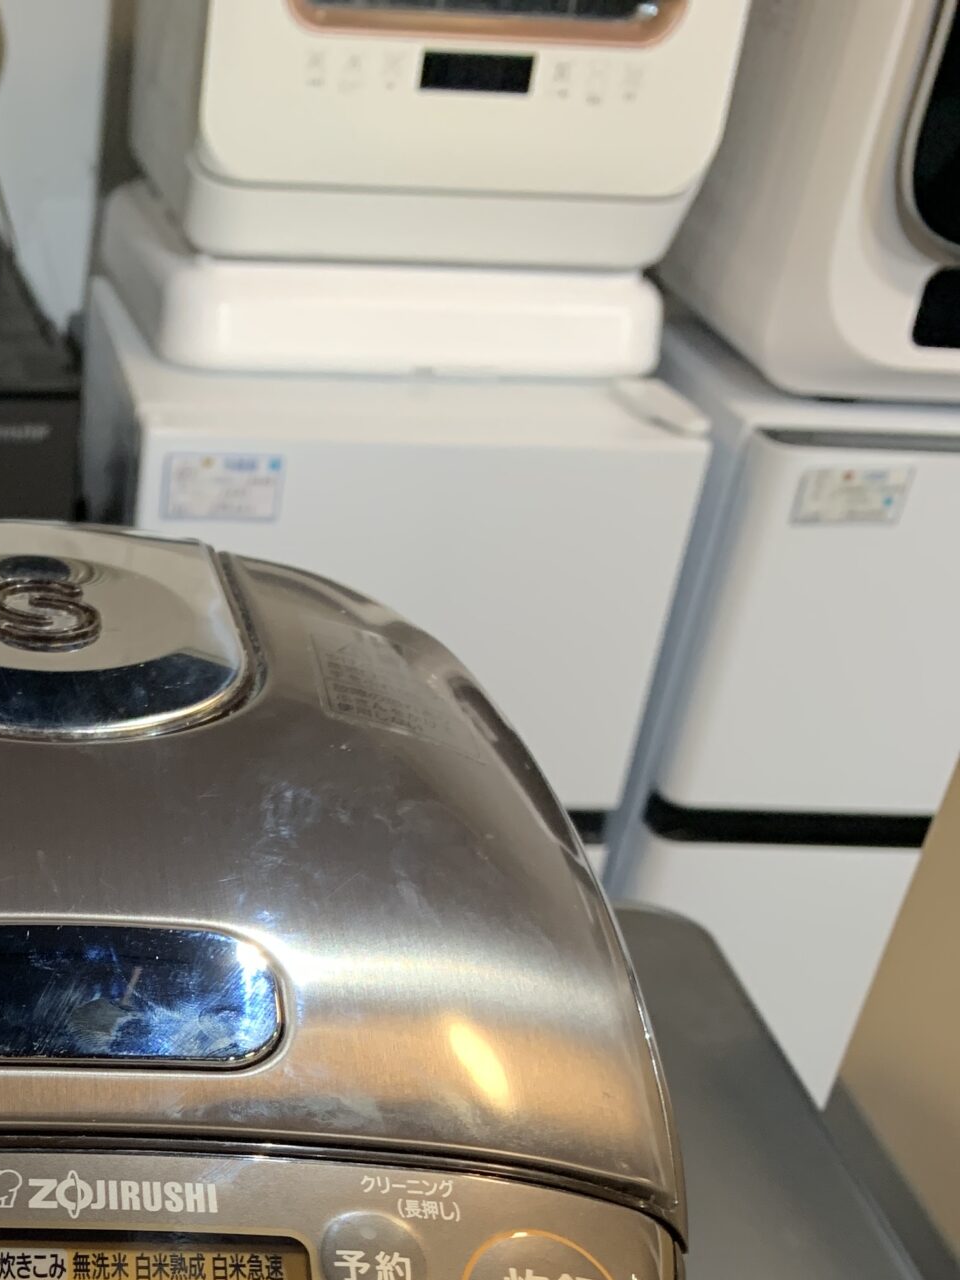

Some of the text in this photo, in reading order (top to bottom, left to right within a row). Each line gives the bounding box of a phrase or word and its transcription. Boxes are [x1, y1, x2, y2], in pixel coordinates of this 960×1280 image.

[28, 1170, 218, 1219] ZOJIRUSHI
[360, 1175, 454, 1198] クリーニング
[72, 1253, 129, 1280] 無洗米
